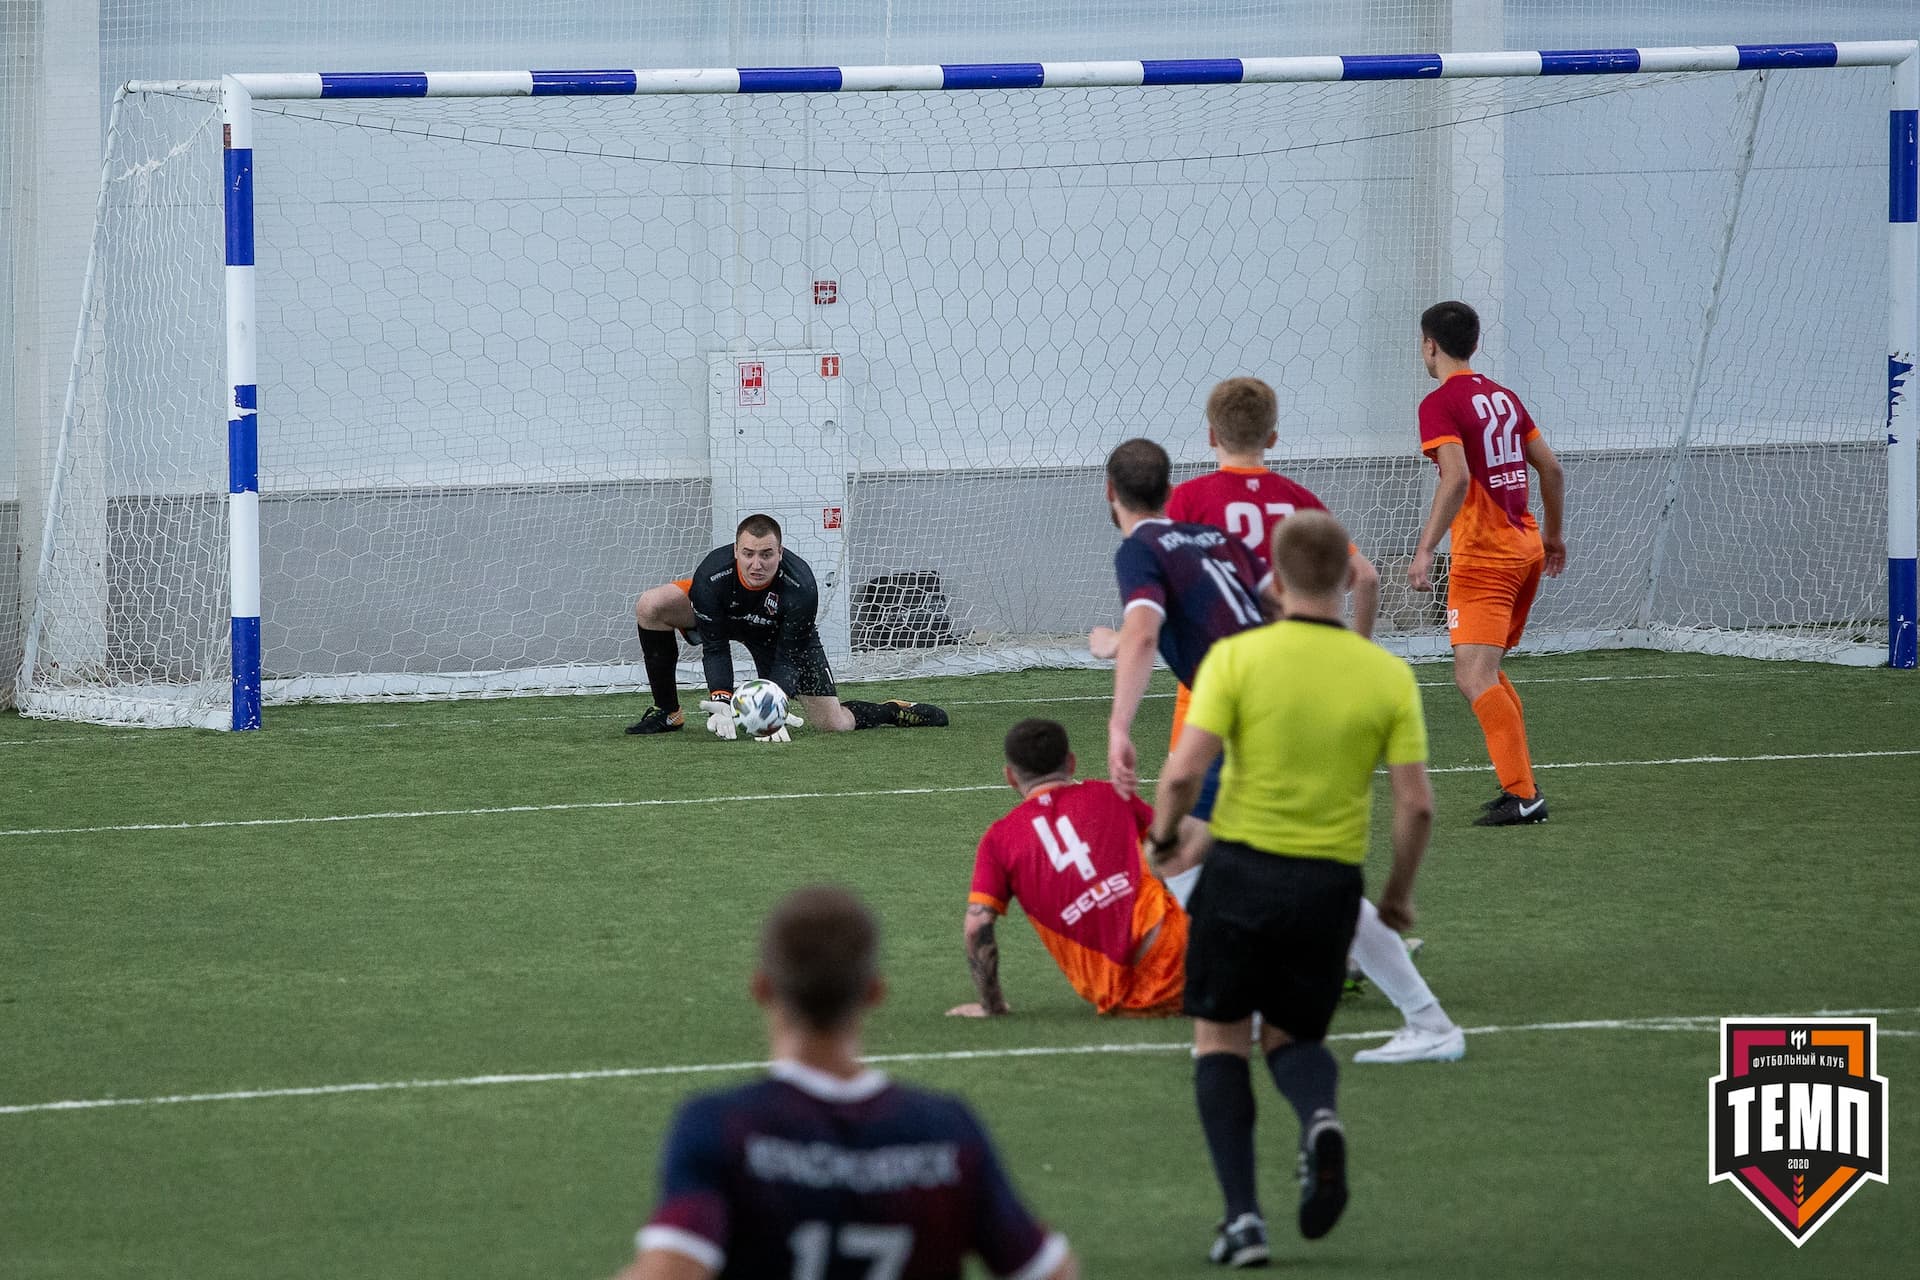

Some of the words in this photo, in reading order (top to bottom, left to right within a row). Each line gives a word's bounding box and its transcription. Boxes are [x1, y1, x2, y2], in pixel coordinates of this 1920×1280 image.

[1472, 391, 1523, 468] 22
[1032, 815, 1097, 881] 4
[1061, 872, 1130, 926] SEUS
